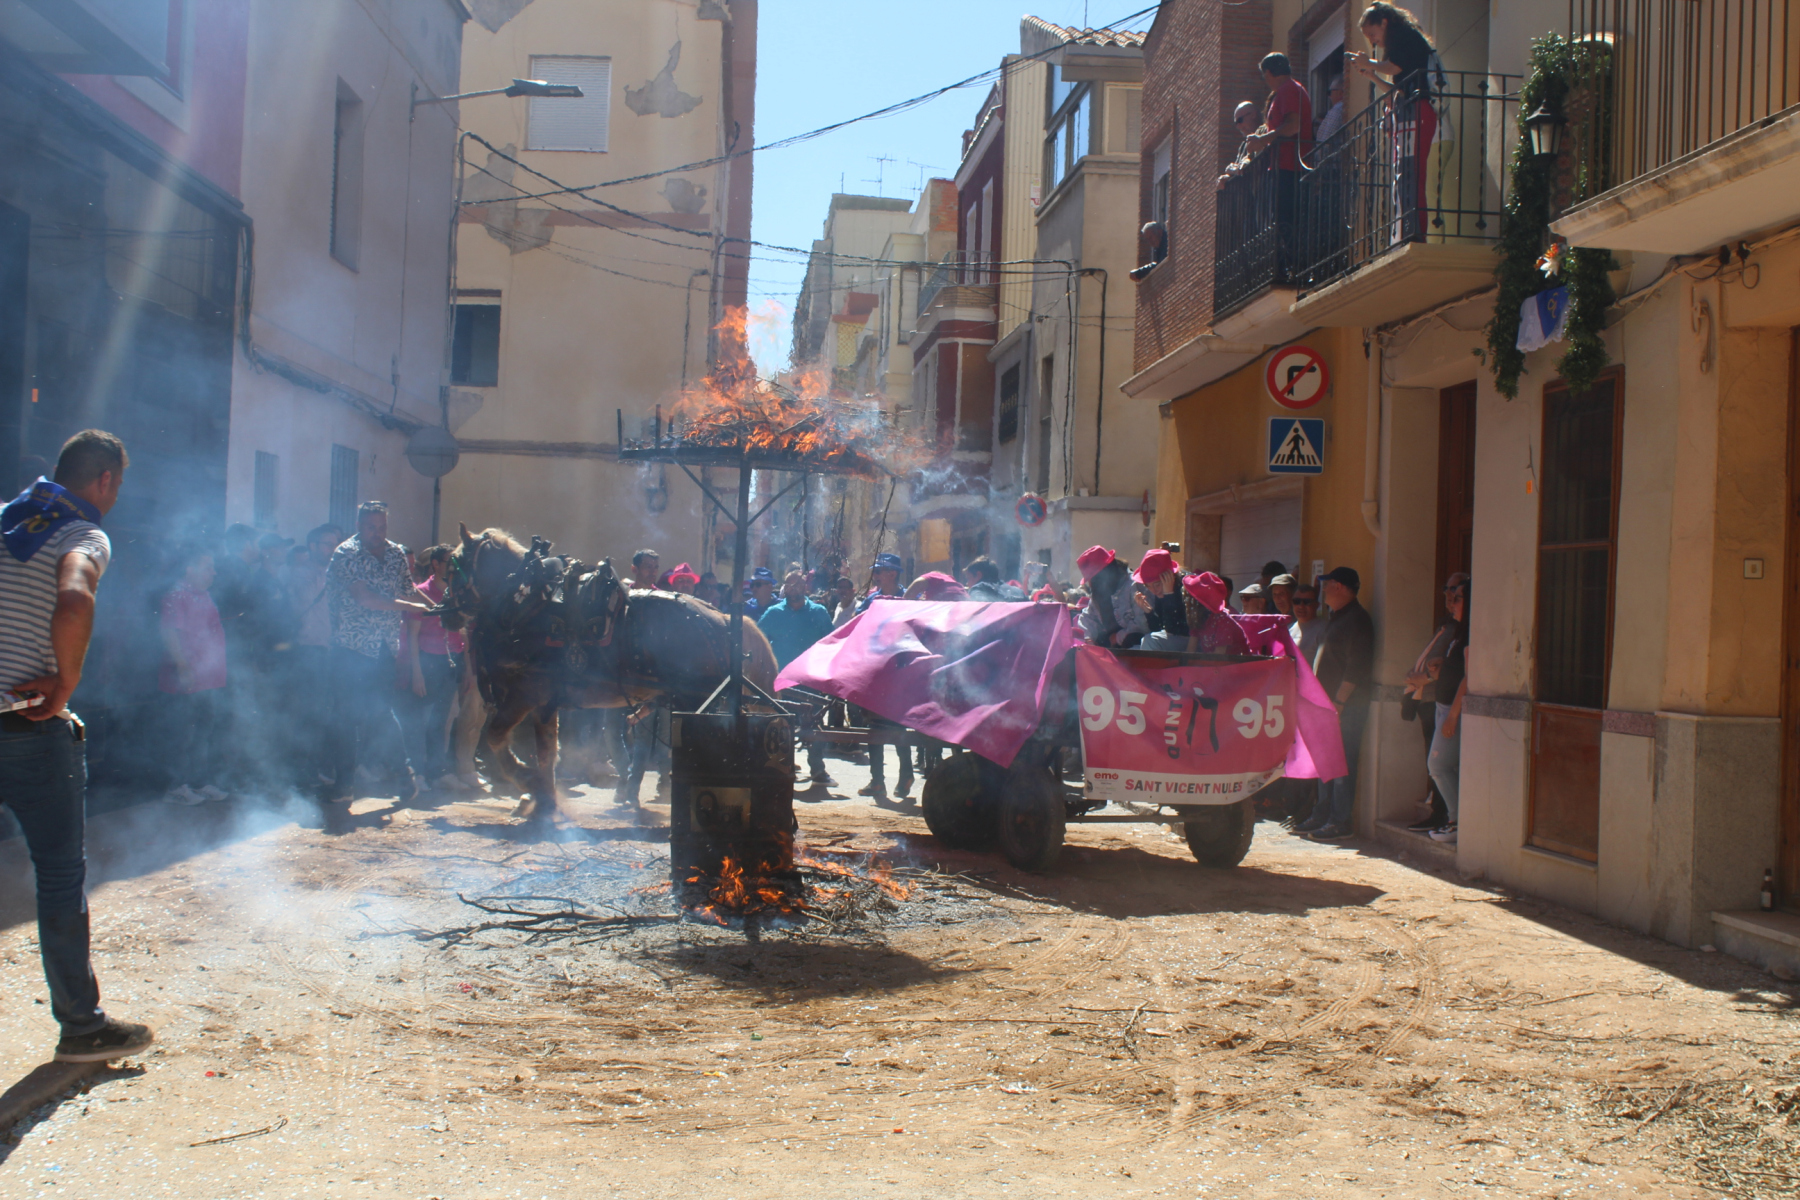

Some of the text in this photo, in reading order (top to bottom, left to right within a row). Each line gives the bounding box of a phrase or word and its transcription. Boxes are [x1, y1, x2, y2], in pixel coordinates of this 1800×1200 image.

[1082, 685, 1149, 736] 95
[1232, 694, 1285, 739] 95
[1124, 779, 1162, 793] SANT
[1164, 780, 1211, 794] VICENT
[1212, 780, 1243, 794] NULES
